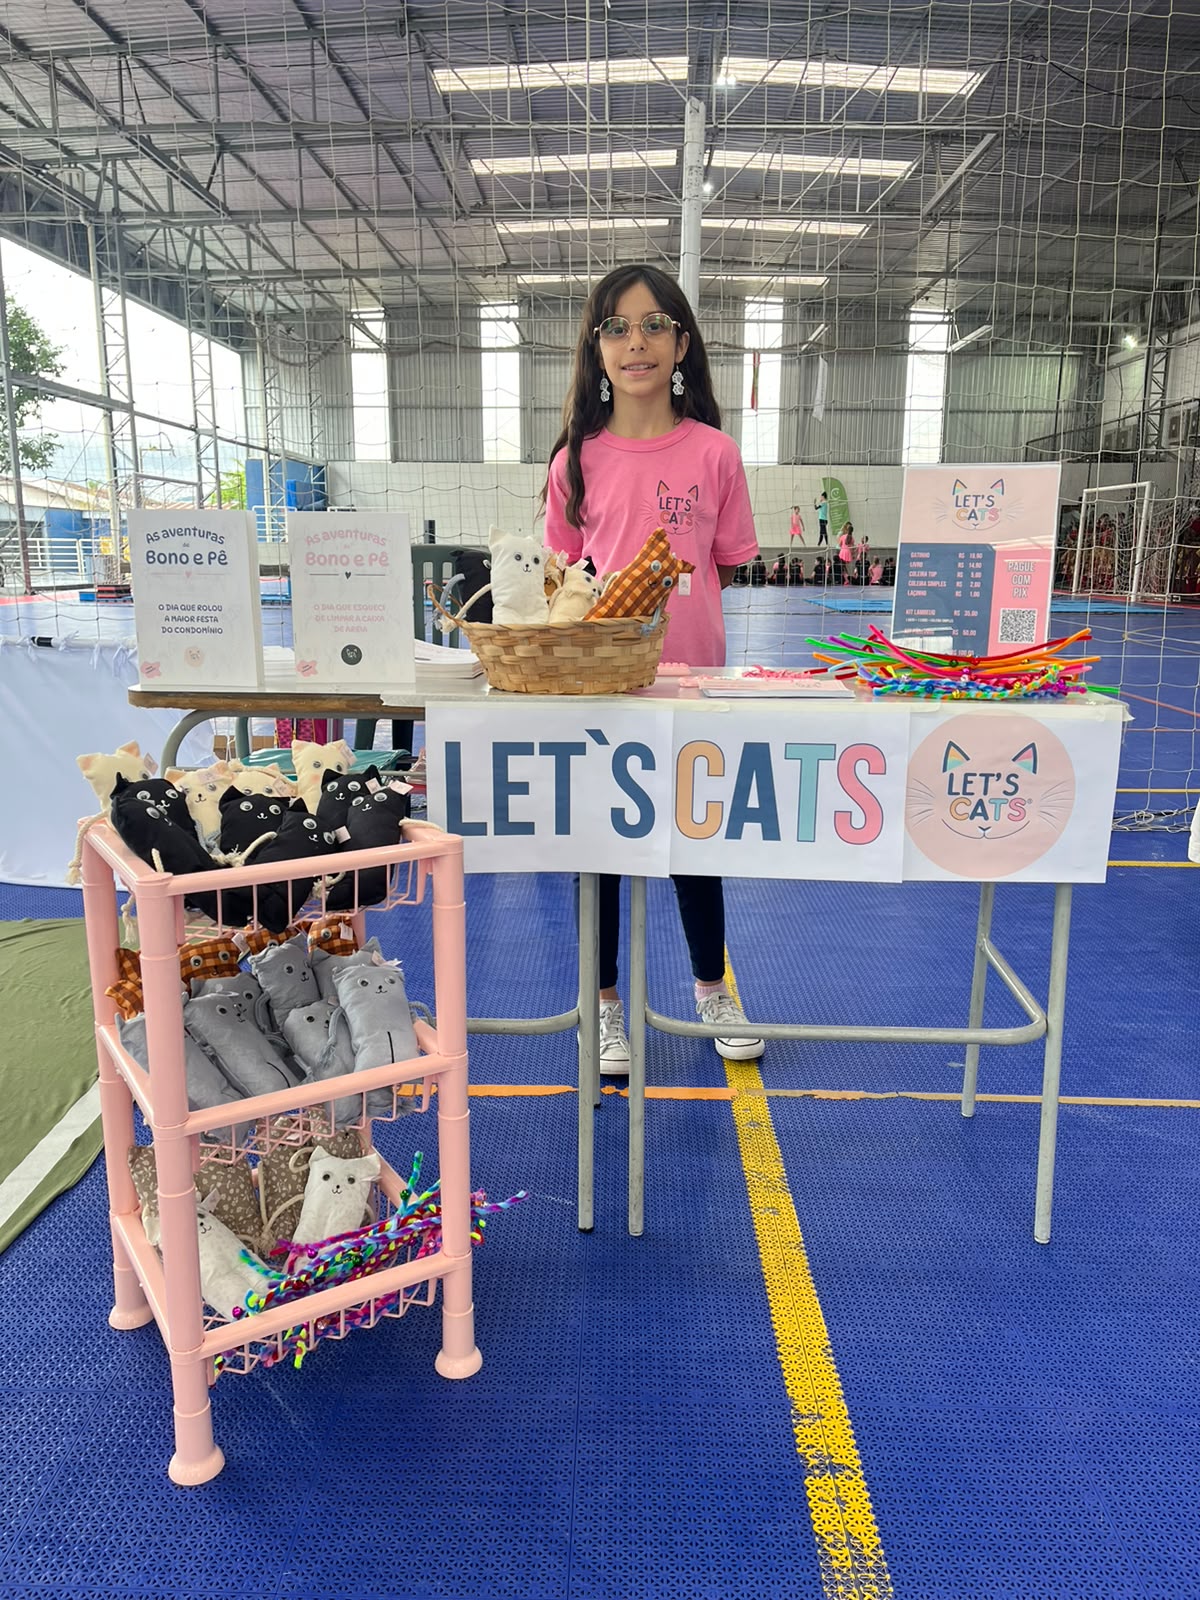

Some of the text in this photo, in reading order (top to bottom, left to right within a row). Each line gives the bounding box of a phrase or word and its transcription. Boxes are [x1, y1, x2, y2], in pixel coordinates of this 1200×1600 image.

[659, 496, 691, 512] LET'S
[955, 494, 994, 507] LET'S
[660, 510, 694, 526] CATS
[956, 508, 1000, 521] CATS
[146, 526, 225, 545] As aventuras
[305, 528, 387, 547] As aventuras
[146, 550, 228, 566] Bono e Pê
[305, 551, 390, 567] Bono e Pê
[1007, 561, 1035, 572] PAGUE
[1012, 574, 1031, 585] COM
[1013, 588, 1028, 598] PIX
[180, 604, 196, 612] QUE
[197, 604, 223, 612] ROLOU
[353, 604, 385, 612] ESQUECI
[161, 626, 223, 634] DO CONDOMÍNIO
[947, 772, 1019, 796] LET'S
[675, 739, 887, 845] CATS
